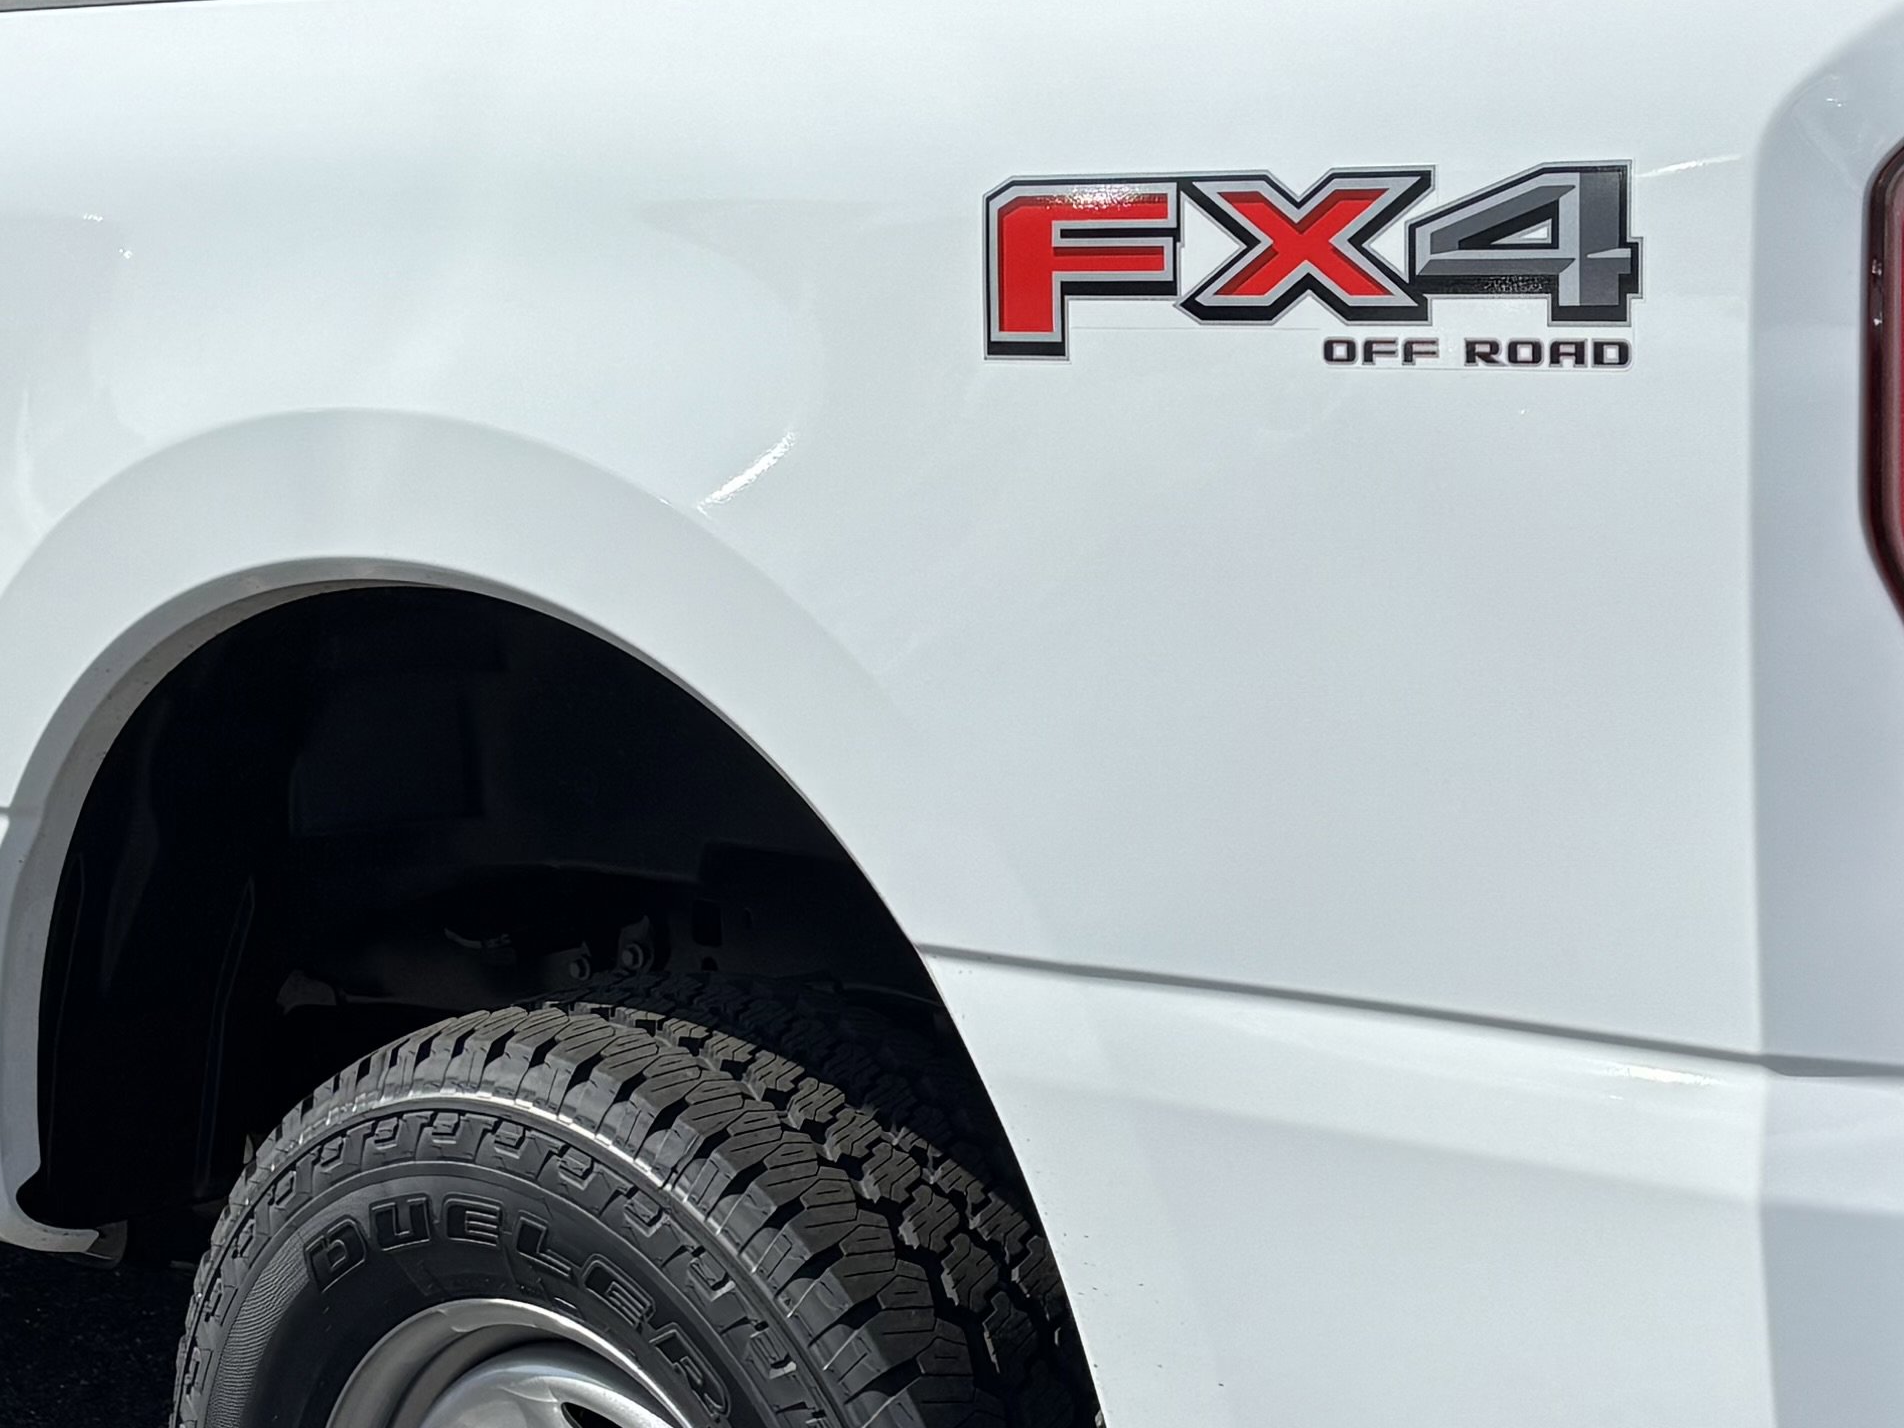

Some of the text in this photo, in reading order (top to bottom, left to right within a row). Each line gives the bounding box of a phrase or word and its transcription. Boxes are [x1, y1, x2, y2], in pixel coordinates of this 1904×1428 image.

[983, 160, 1643, 361] FX4
[1323, 337, 1634, 369] OFF ROAD
[304, 1193, 731, 1422] DUELER
